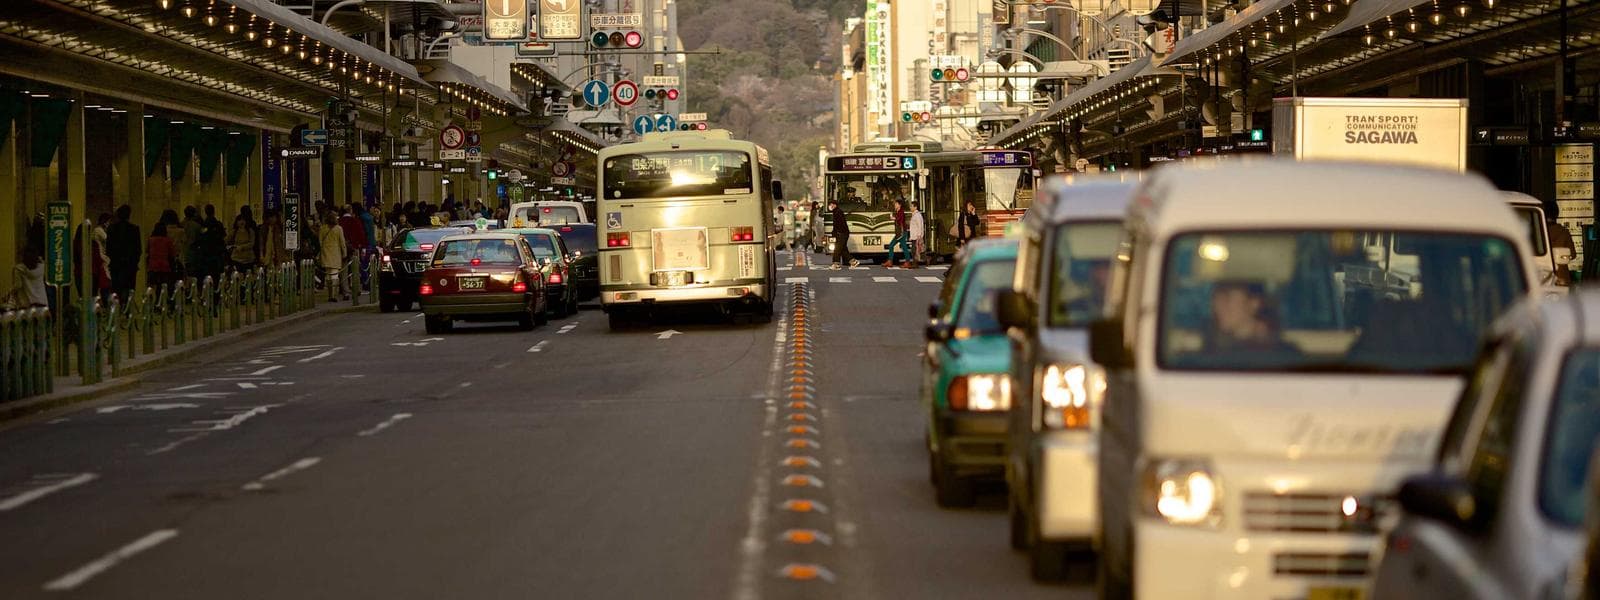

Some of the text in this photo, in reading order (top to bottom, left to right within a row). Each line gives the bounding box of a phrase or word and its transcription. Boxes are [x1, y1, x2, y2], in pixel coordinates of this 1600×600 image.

[619, 88, 633, 99] 40
[1345, 131, 1418, 144] SAGAWA
[700, 155, 720, 172] 12
[886, 157, 897, 167] 5
[50, 206, 68, 214] TAXI
